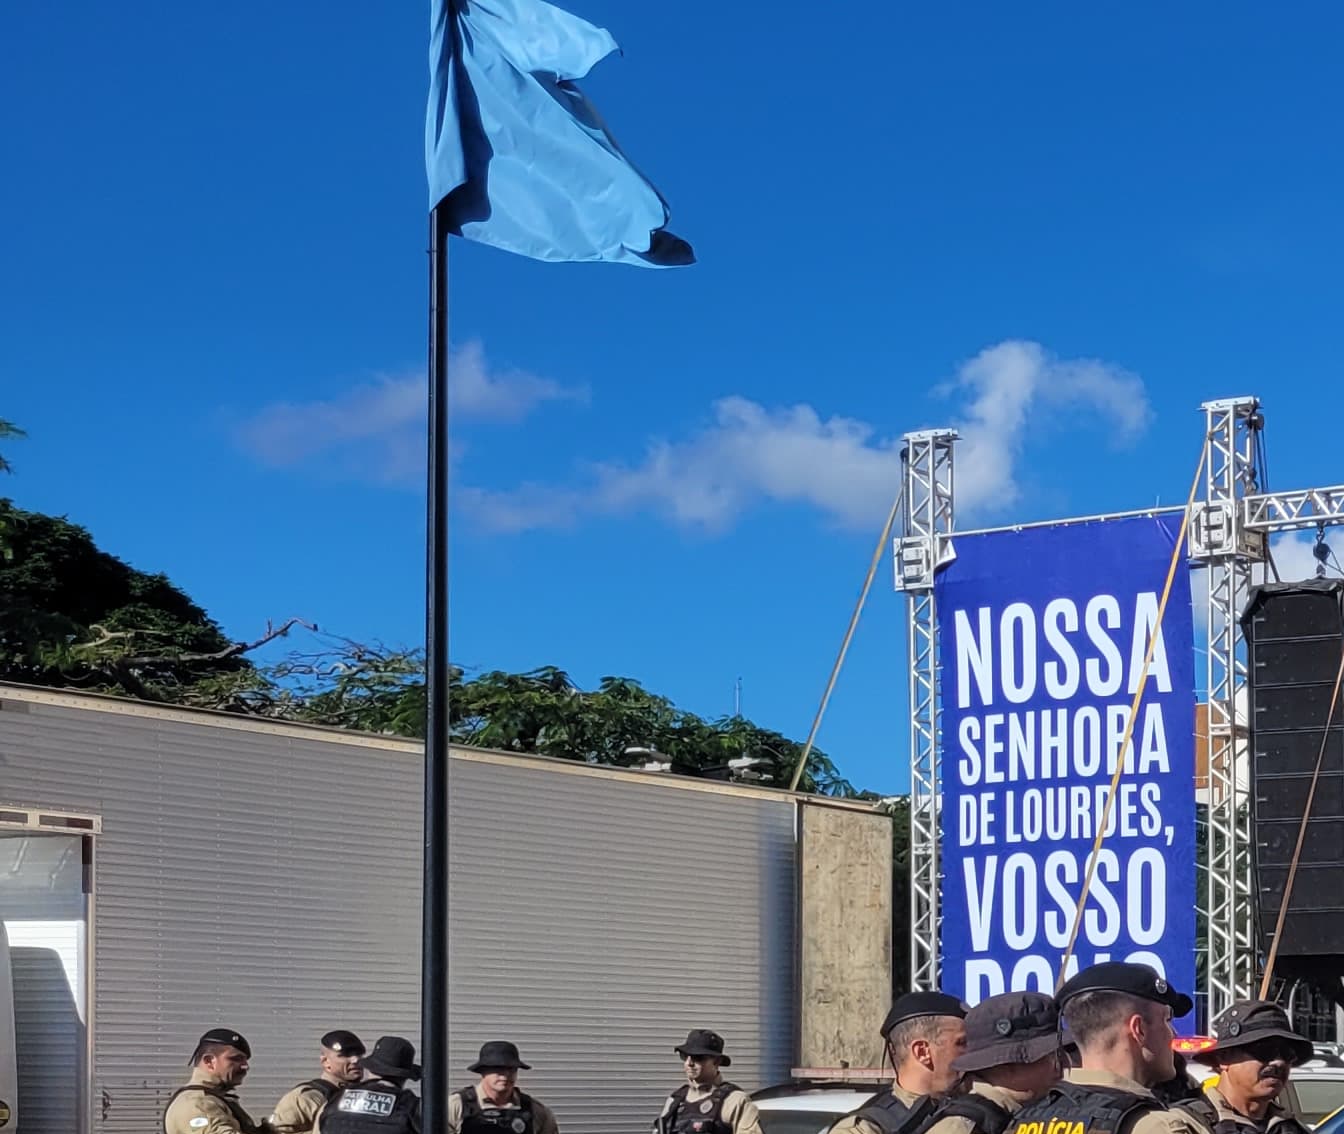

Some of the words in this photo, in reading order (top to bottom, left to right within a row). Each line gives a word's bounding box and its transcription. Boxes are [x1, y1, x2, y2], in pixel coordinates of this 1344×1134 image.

[954, 591, 1172, 709] NOSSA
[958, 702, 1170, 786] SENHORA
[959, 792, 996, 847] DE
[1006, 782, 1174, 846] LOURDES,
[962, 847, 1166, 952] VOSSO
[344, 1091, 392, 1104] PATULHA
